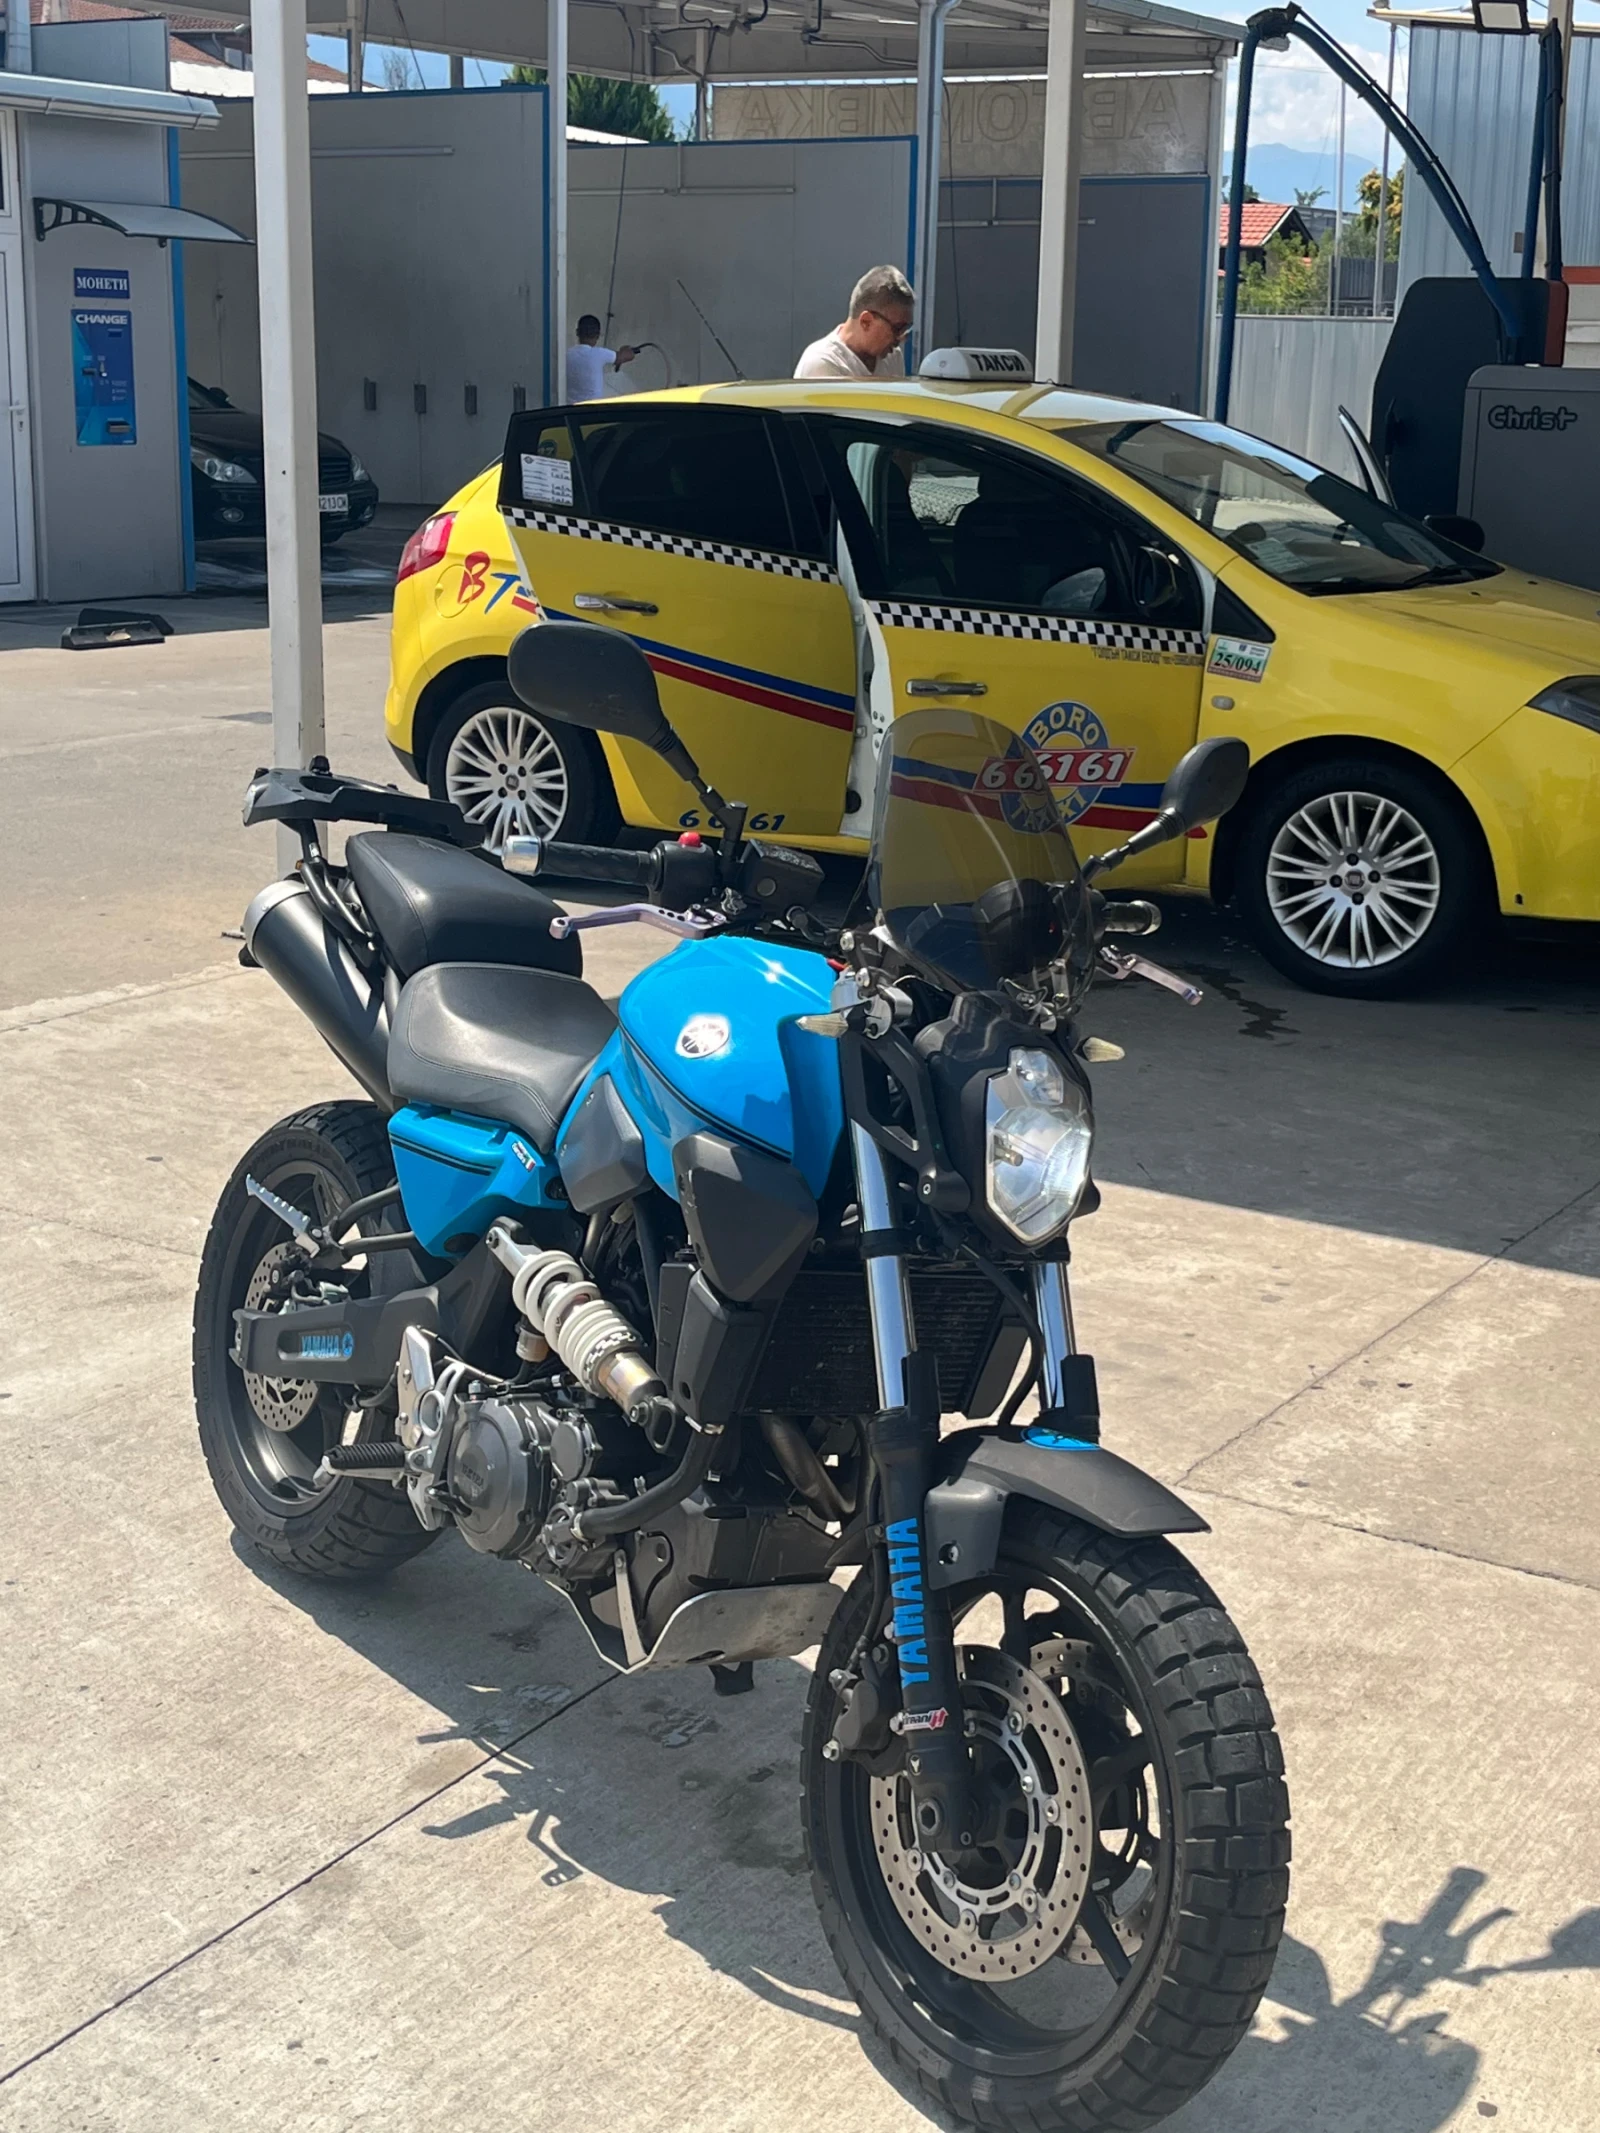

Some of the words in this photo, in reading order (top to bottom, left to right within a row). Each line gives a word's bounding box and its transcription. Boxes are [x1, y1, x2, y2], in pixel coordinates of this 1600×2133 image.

[76, 276, 128, 290] МОНЕТИ
[75, 314, 128, 325] CHANGE
[970, 354, 1026, 372] ТАКСИ
[1488, 405, 1578, 431] Christ
[1214, 652, 1262, 675] 25/094
[1029, 706, 1100, 746] BORO
[301, 1334, 340, 1358] YAMAHA
[886, 1518, 930, 1690] YAMAHA
